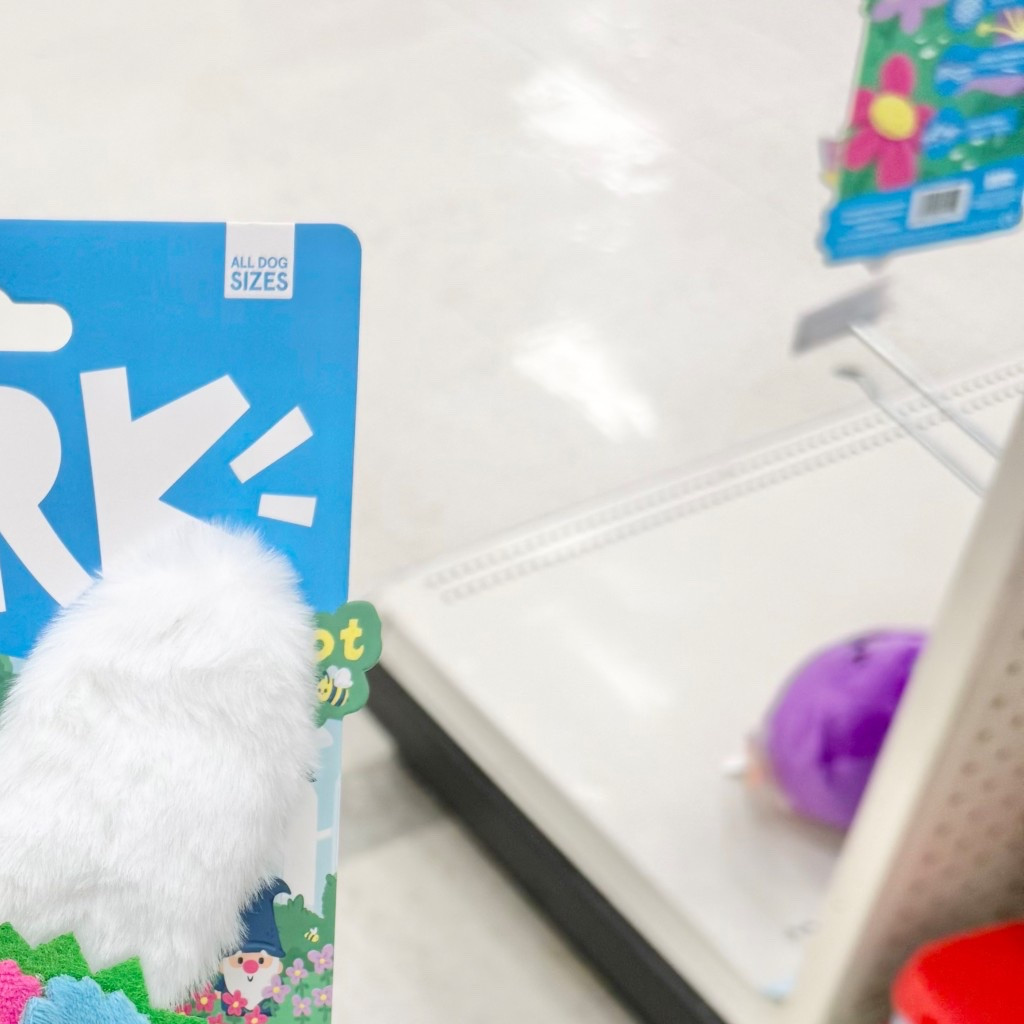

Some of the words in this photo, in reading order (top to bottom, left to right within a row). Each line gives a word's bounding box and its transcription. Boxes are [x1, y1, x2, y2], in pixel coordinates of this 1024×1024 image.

[230, 256, 255, 269] ALL
[258, 256, 288, 269] DOG
[230, 271, 288, 292] SIZES
